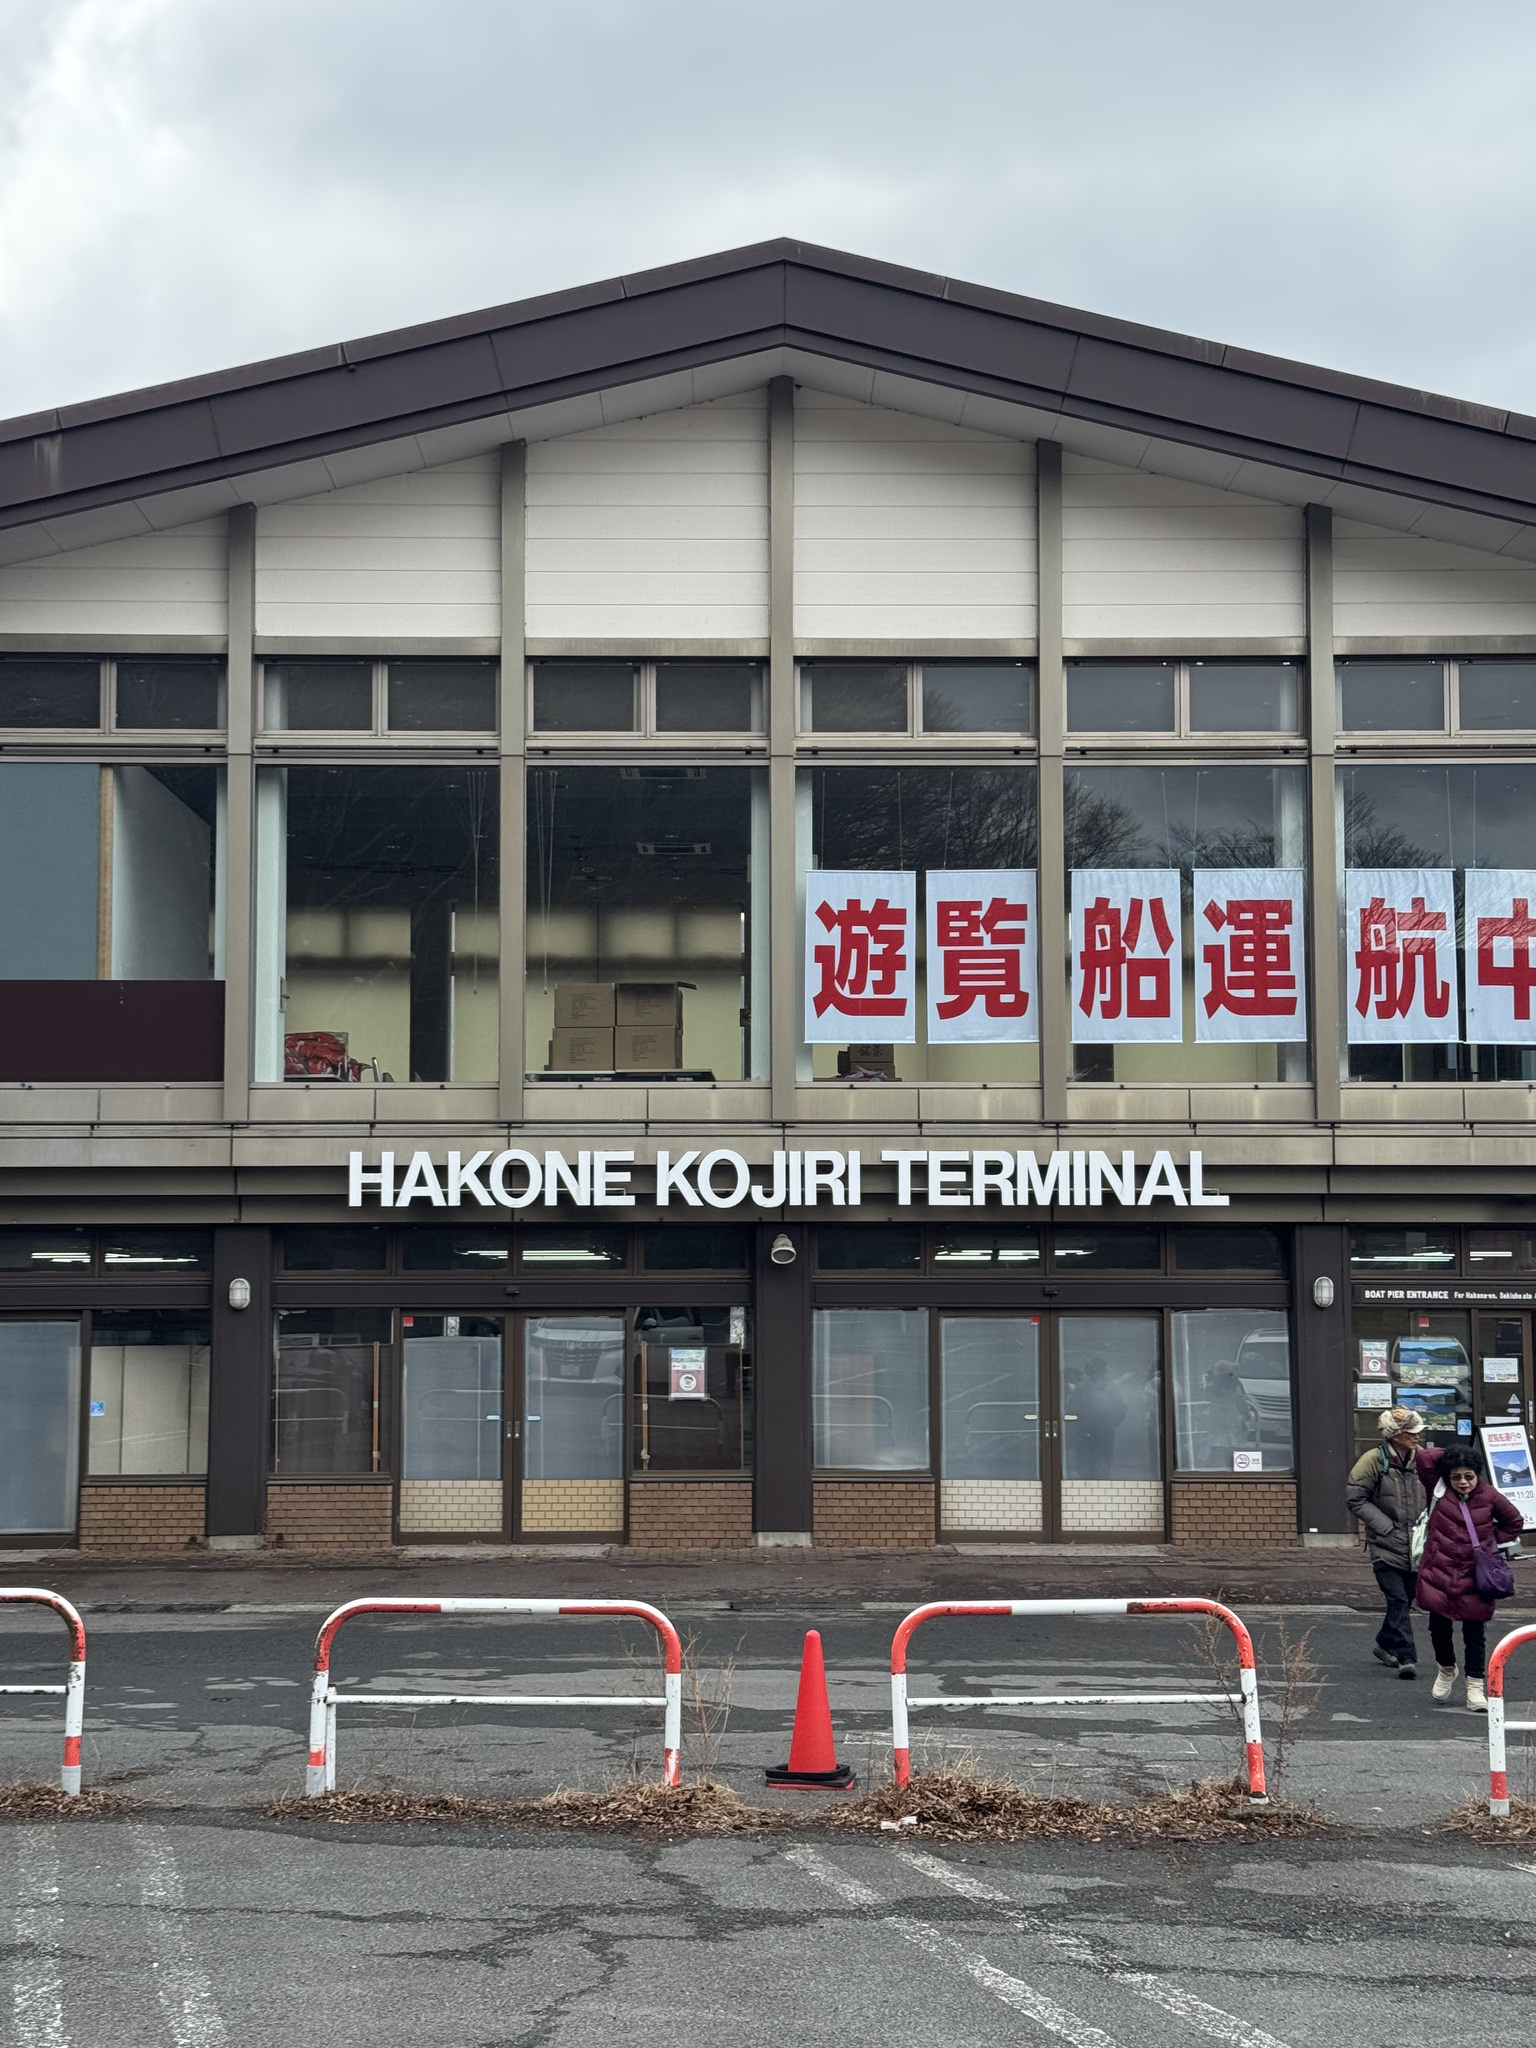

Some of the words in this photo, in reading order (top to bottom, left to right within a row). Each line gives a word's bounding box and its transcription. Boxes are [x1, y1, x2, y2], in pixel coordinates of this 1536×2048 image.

[815, 899, 1536, 1019] 遊覧船運航中
[349, 1150, 636, 1209] HAKONE
[656, 1149, 861, 1210] KOJIRI
[881, 1150, 1230, 1207] TERMINAL
[1364, 1290, 1386, 1299] BOAT
[1387, 1290, 1405, 1299] PIER
[1406, 1290, 1449, 1300] ENTRANCE
[1453, 1291, 1465, 1299] For
[1516, 1490, 1534, 1499] 11:20
